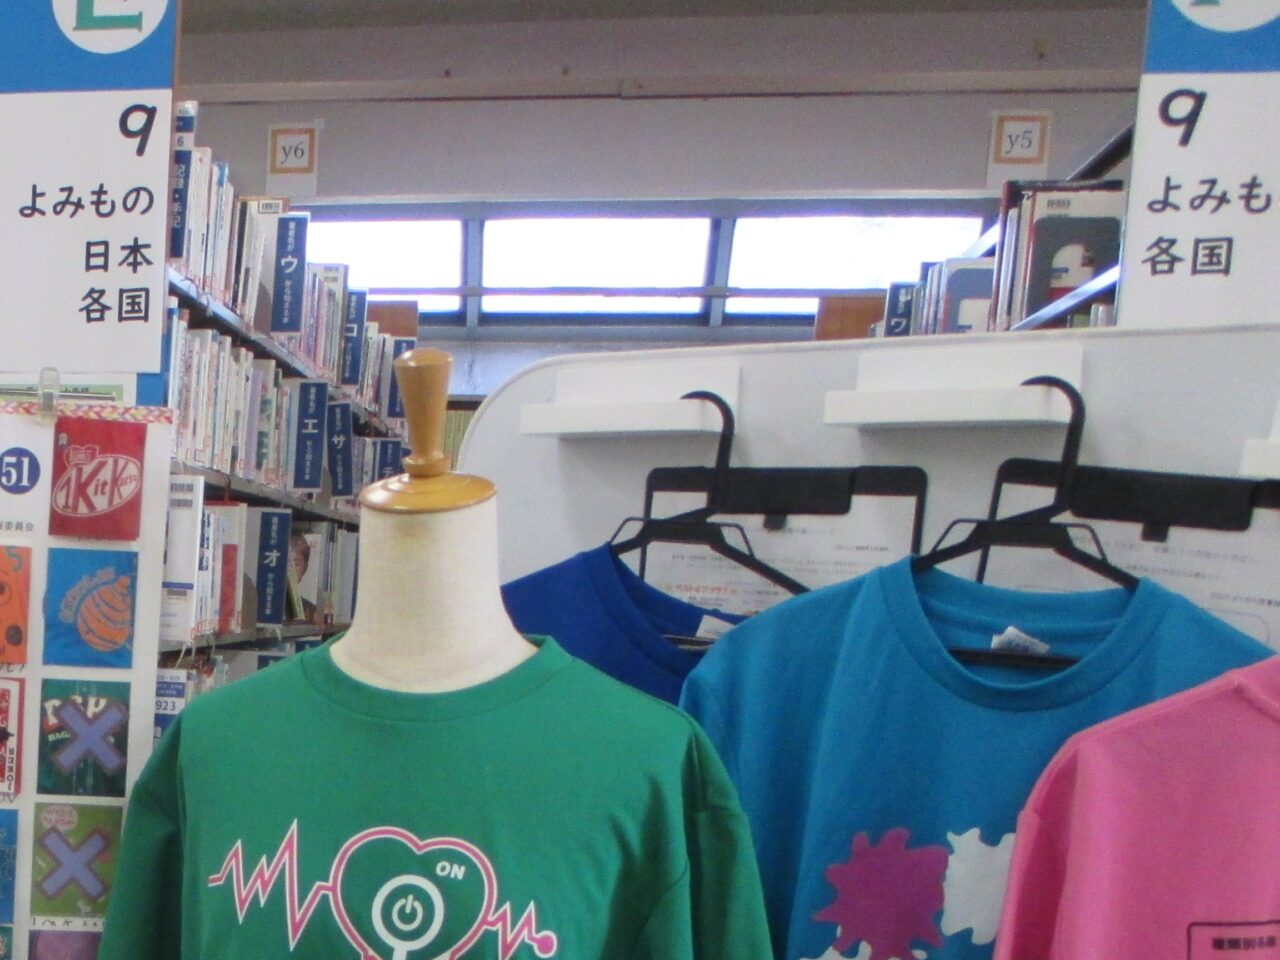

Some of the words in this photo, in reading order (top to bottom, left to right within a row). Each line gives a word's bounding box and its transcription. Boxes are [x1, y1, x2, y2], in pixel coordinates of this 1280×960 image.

[119, 104, 158, 157] 9
[1159, 88, 1208, 147] 9
[280, 141, 305, 164] y6
[1006, 129, 1034, 154] y5
[19, 183, 154, 218] よみもの
[1147, 174, 1272, 215] よみも
[84, 236, 154, 274] 日本
[1141, 236, 1234, 277] 各国
[78, 287, 150, 323] 各国
[1, 456, 32, 487] 51
[435, 860, 466, 881] ON
